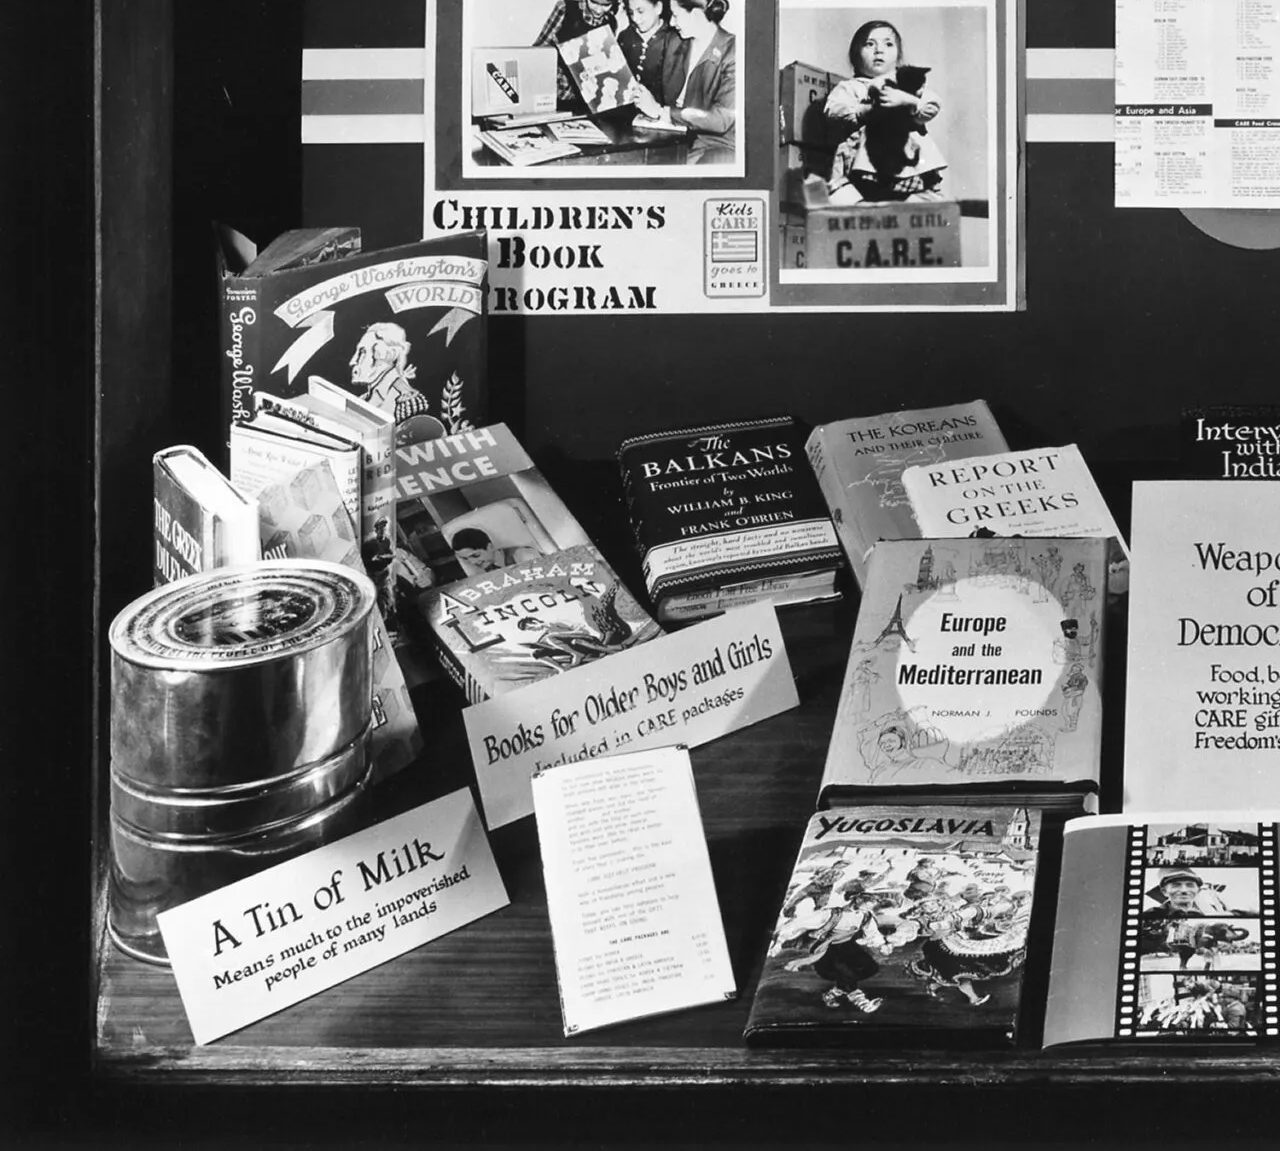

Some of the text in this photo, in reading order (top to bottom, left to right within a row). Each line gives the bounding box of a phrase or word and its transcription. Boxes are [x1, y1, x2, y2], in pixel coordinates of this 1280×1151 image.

[1126, 106, 1196, 116] Europe and Asia
[433, 200, 665, 235] CHILDREN'S
[716, 203, 753, 216] Kids
[711, 217, 758, 229] CARE
[496, 236, 604, 269] BOOK
[837, 237, 944, 268] C.A.R.E.
[394, 286, 474, 306] WORLD
[642, 442, 792, 479] BALKANS
[929, 454, 1058, 491] REPORT
[962, 481, 1045, 499] ON THE
[946, 490, 1079, 524] GREEKS
[1247, 579, 1280, 607] of
[941, 613, 1006, 636] Europe
[952, 643, 1002, 656] and the
[898, 664, 1042, 685] Mediterranean
[483, 634, 772, 765] Books for Older Boys and Girls
[815, 816, 999, 840] YUGOSLAVIA
[213, 838, 450, 956] A Tin of Milk
